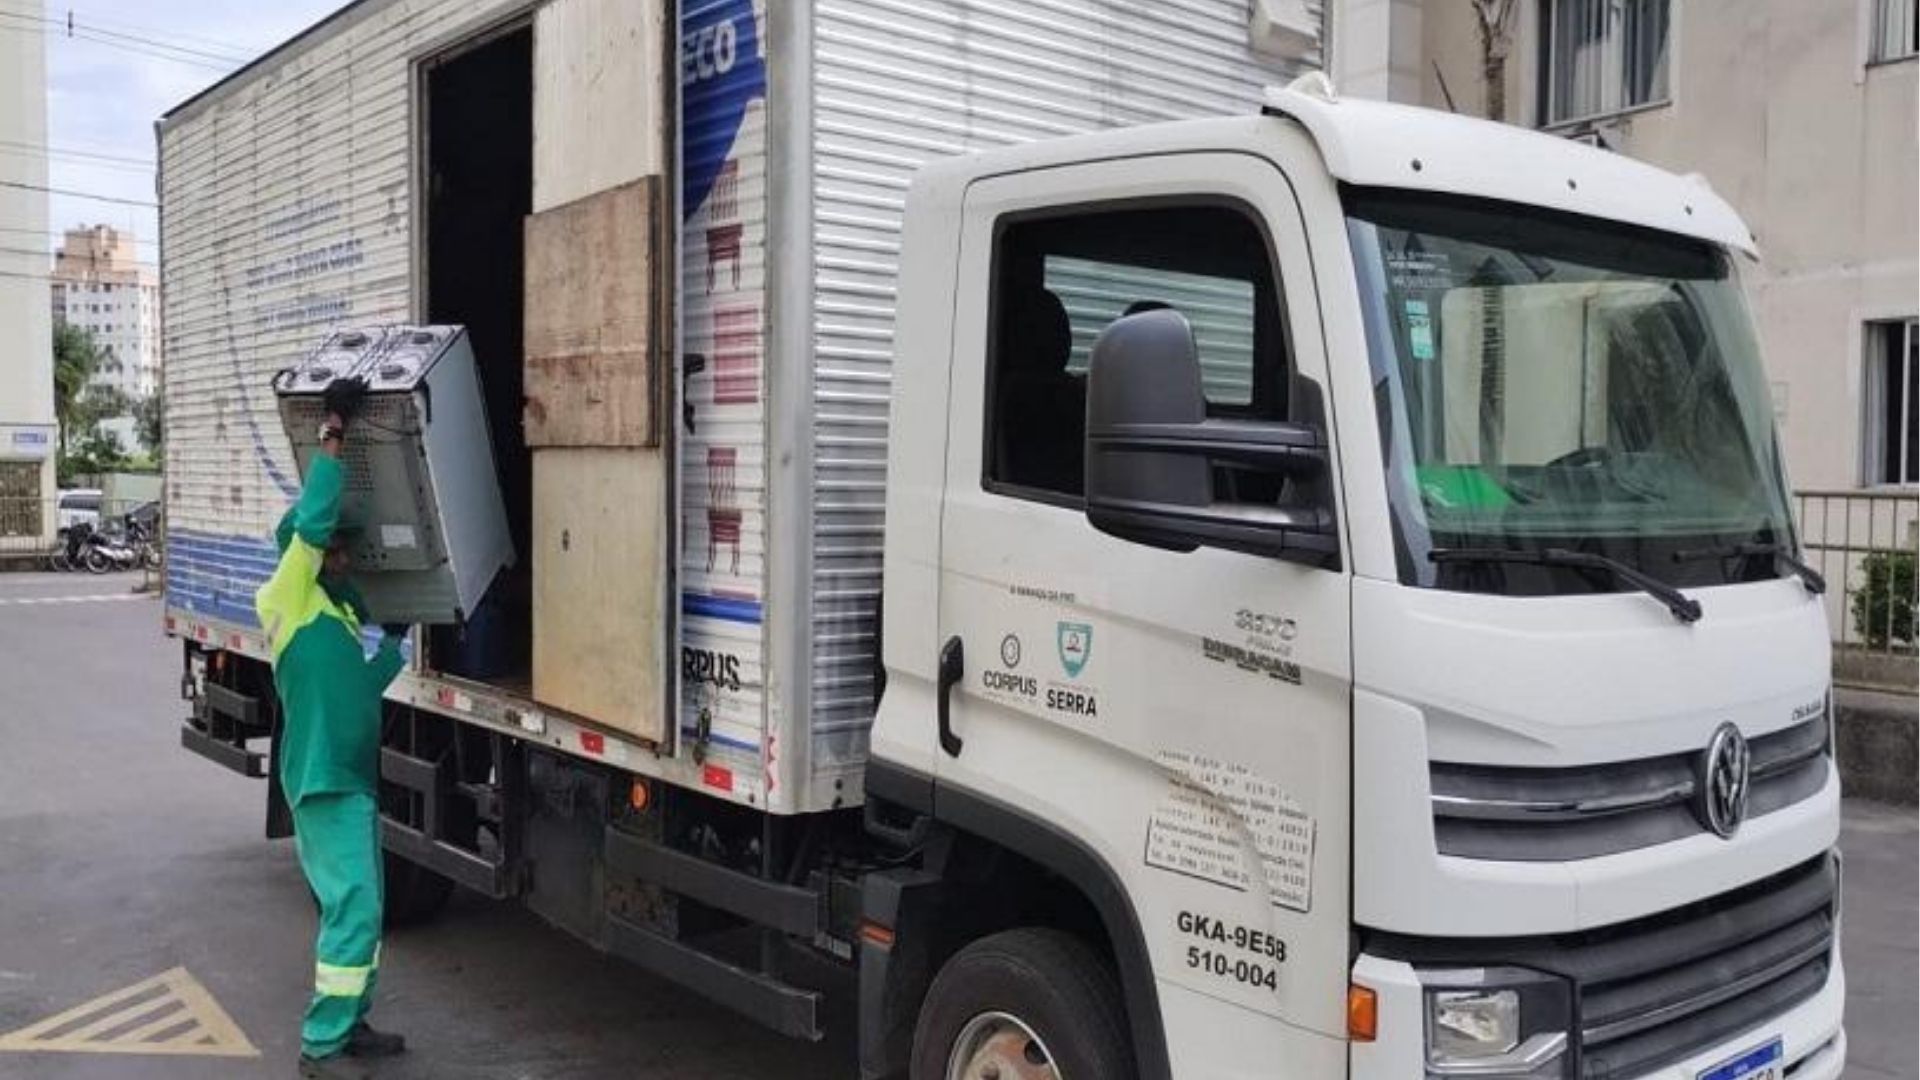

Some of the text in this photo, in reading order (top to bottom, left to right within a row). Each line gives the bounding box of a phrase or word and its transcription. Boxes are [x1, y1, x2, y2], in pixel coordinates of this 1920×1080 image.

[983, 670, 1038, 697] CORPUS
[1046, 688, 1097, 717] SERRA
[1177, 910, 1287, 963] GKA-9E58
[1187, 945, 1277, 992] 510-004
